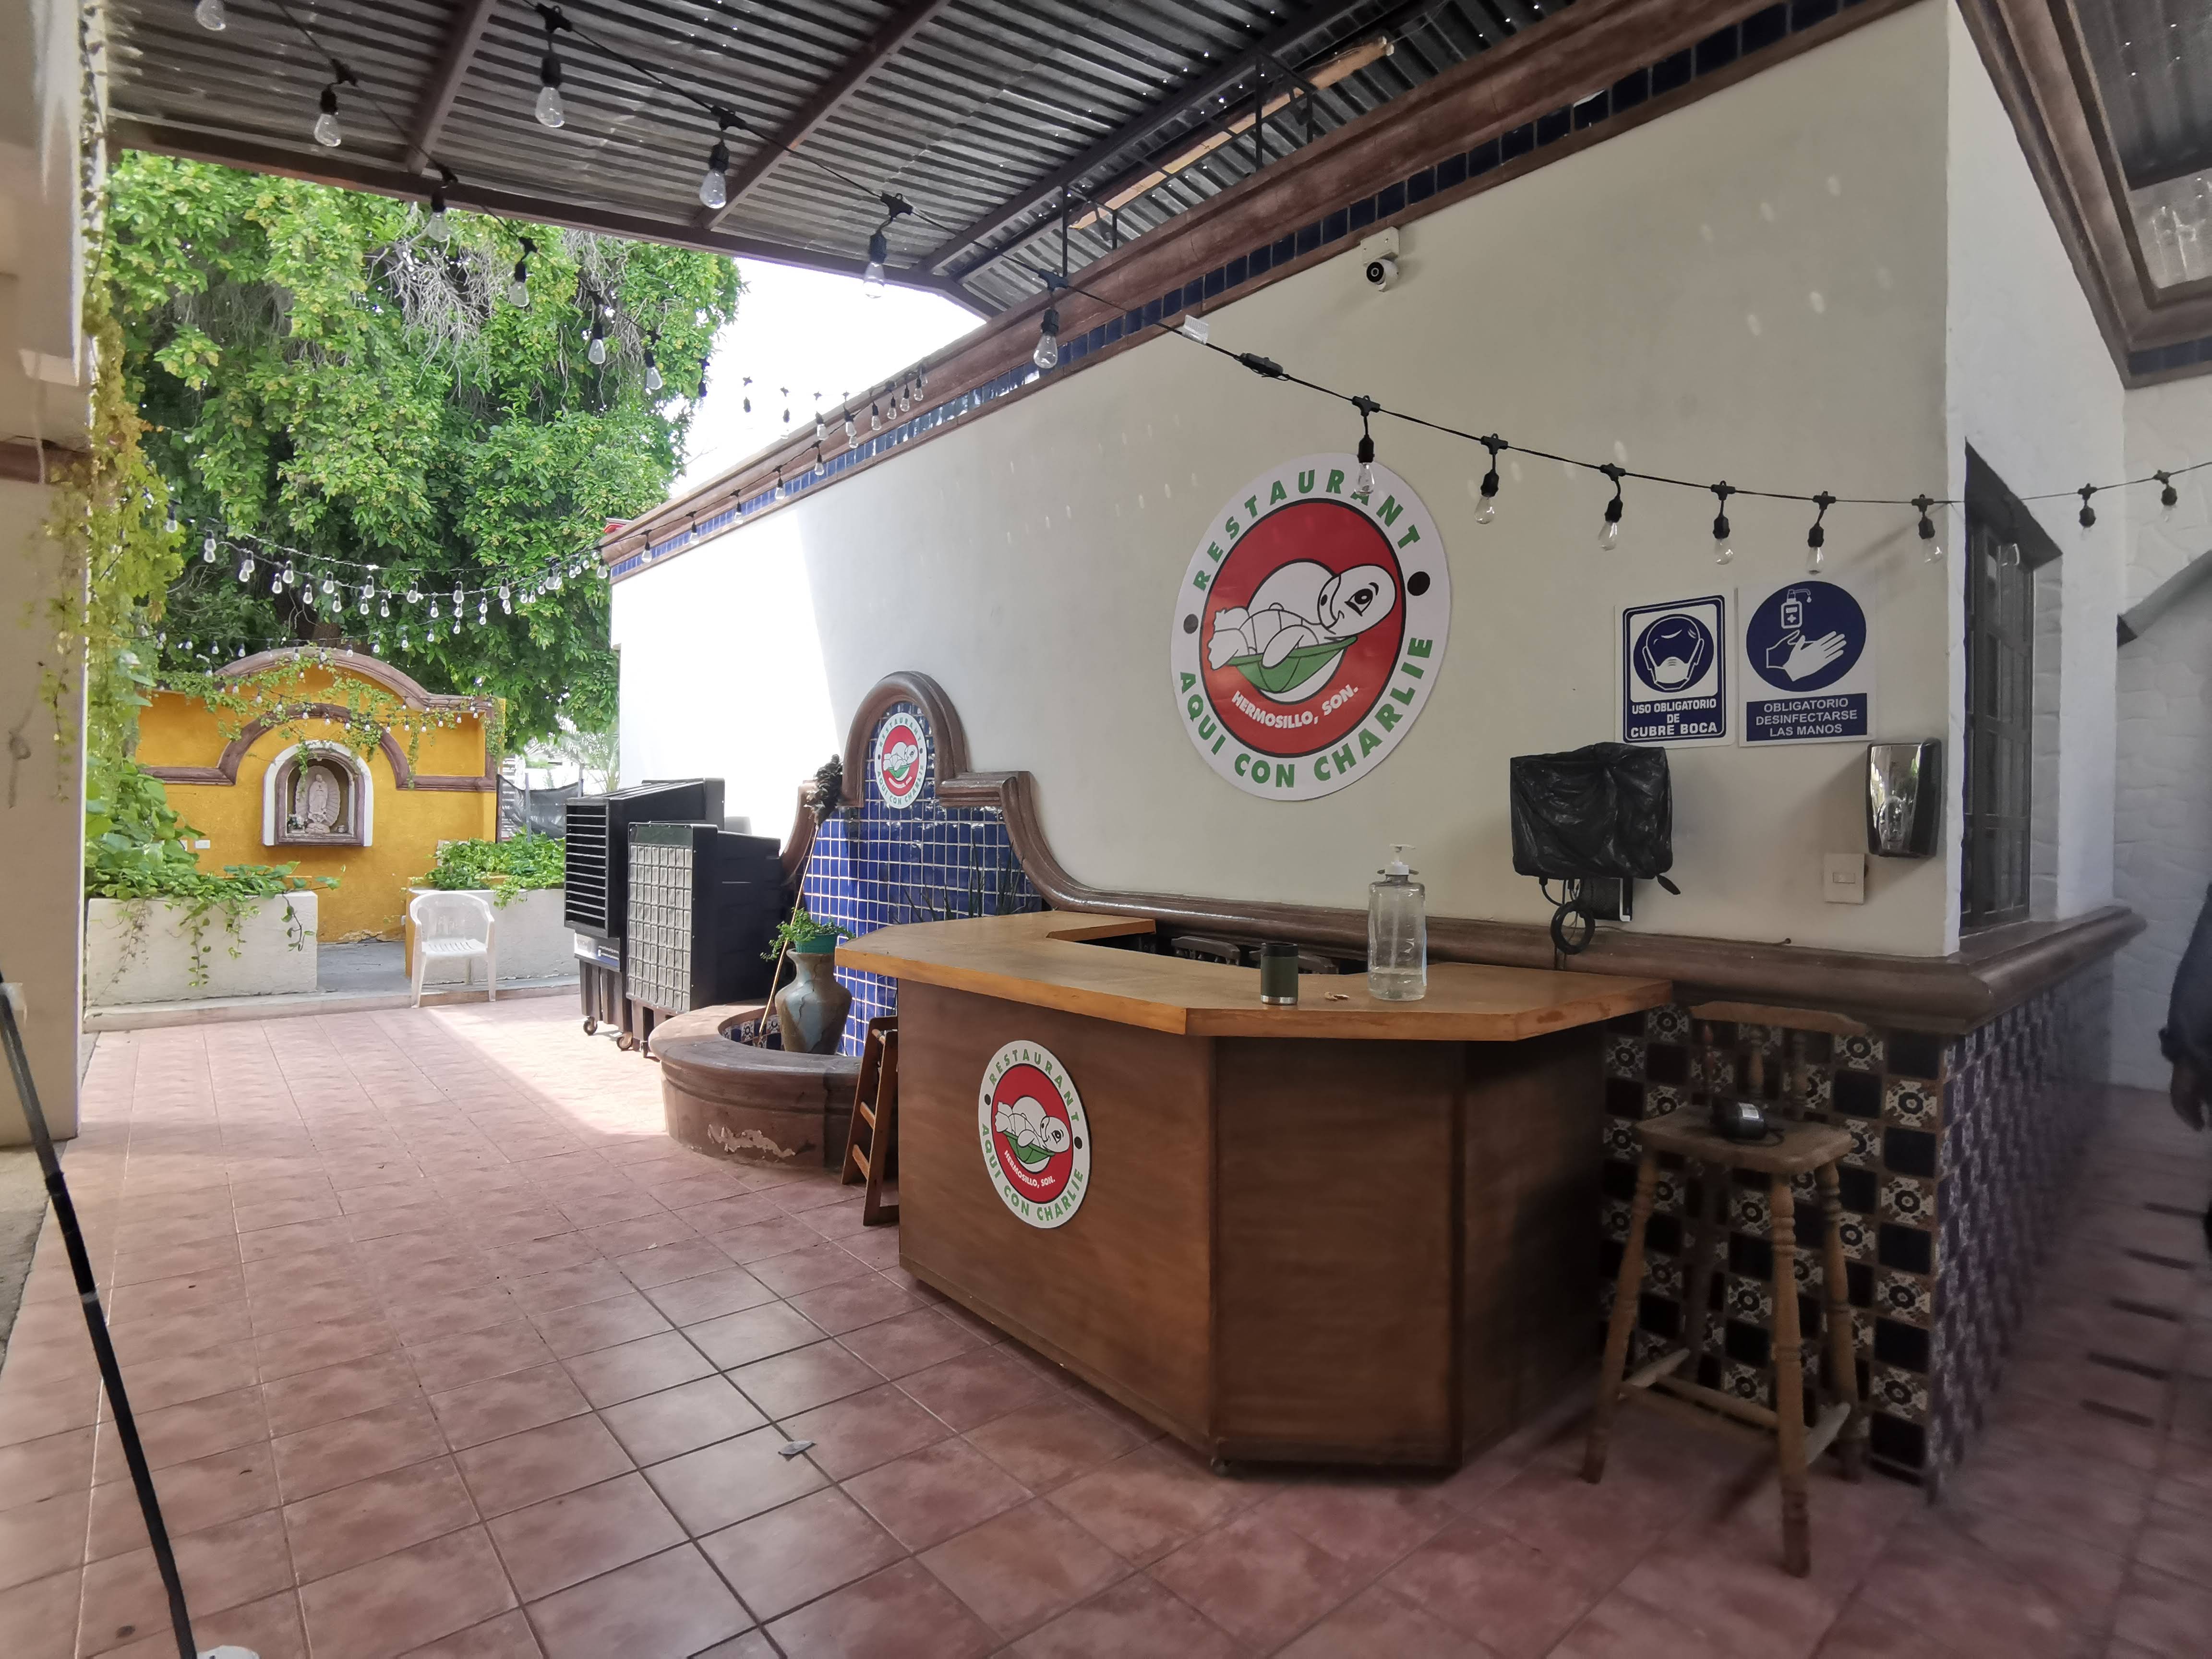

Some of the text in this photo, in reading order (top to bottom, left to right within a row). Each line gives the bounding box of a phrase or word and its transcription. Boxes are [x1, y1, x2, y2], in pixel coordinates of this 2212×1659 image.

[1193, 469, 1420, 591] RESTAURANT
[1180, 637, 1433, 788] AQUI CON CHARLIE
[1231, 684, 1358, 729] HERMOSILLO, SON.
[1632, 698, 1717, 715] USO OBLIGATORIO
[1666, 713, 1680, 724] DE
[1755, 709, 1858, 726] DESINFECTARSE
[1764, 697, 1849, 713] OBLIGATORIO
[1631, 721, 1717, 738] CUBRE BOCA
[1769, 723, 1842, 737] LAS MANOS
[989, 1048, 1080, 1122] RESTAURANT
[982, 1123, 1083, 1221] AQUI CON CHARLIE
[1004, 1150, 1056, 1188] HERMOSILLO, SON.
